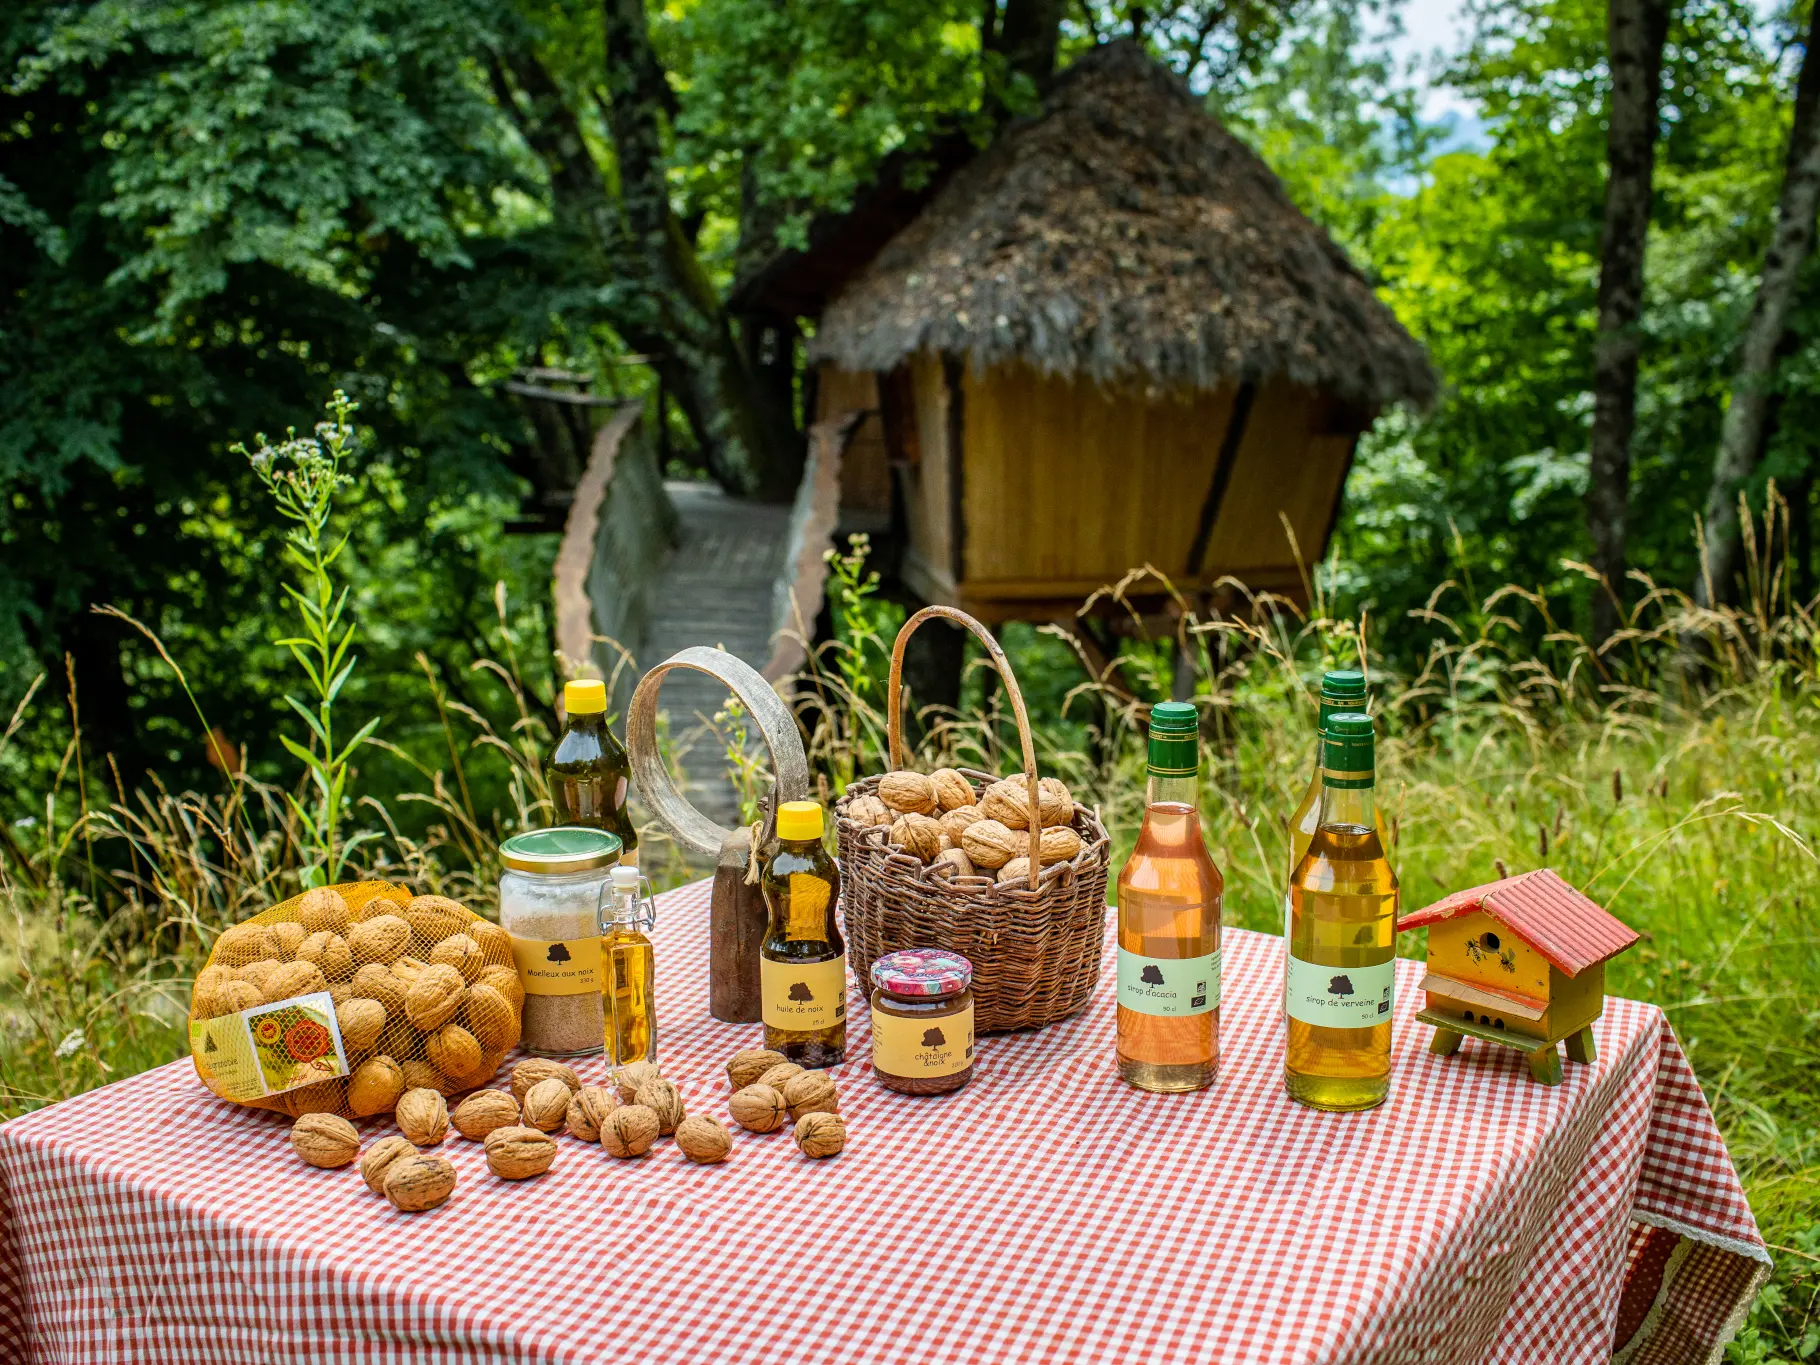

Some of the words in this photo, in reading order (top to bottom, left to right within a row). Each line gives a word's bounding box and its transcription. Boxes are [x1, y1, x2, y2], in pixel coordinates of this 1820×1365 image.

[527, 968, 560, 978] Moelleux
[578, 968, 594, 976] noix
[1127, 984, 1144, 996] sirop
[1145, 989, 1177, 999] d'acacia
[1306, 995, 1326, 1007] sirop
[1327, 998, 1339, 1007] de
[1341, 998, 1375, 1007] verveine
[776, 1004, 794, 1013] huile
[795, 1005, 806, 1013] de
[807, 1004, 824, 1013] noix
[914, 1051, 953, 1061] châtaigne
